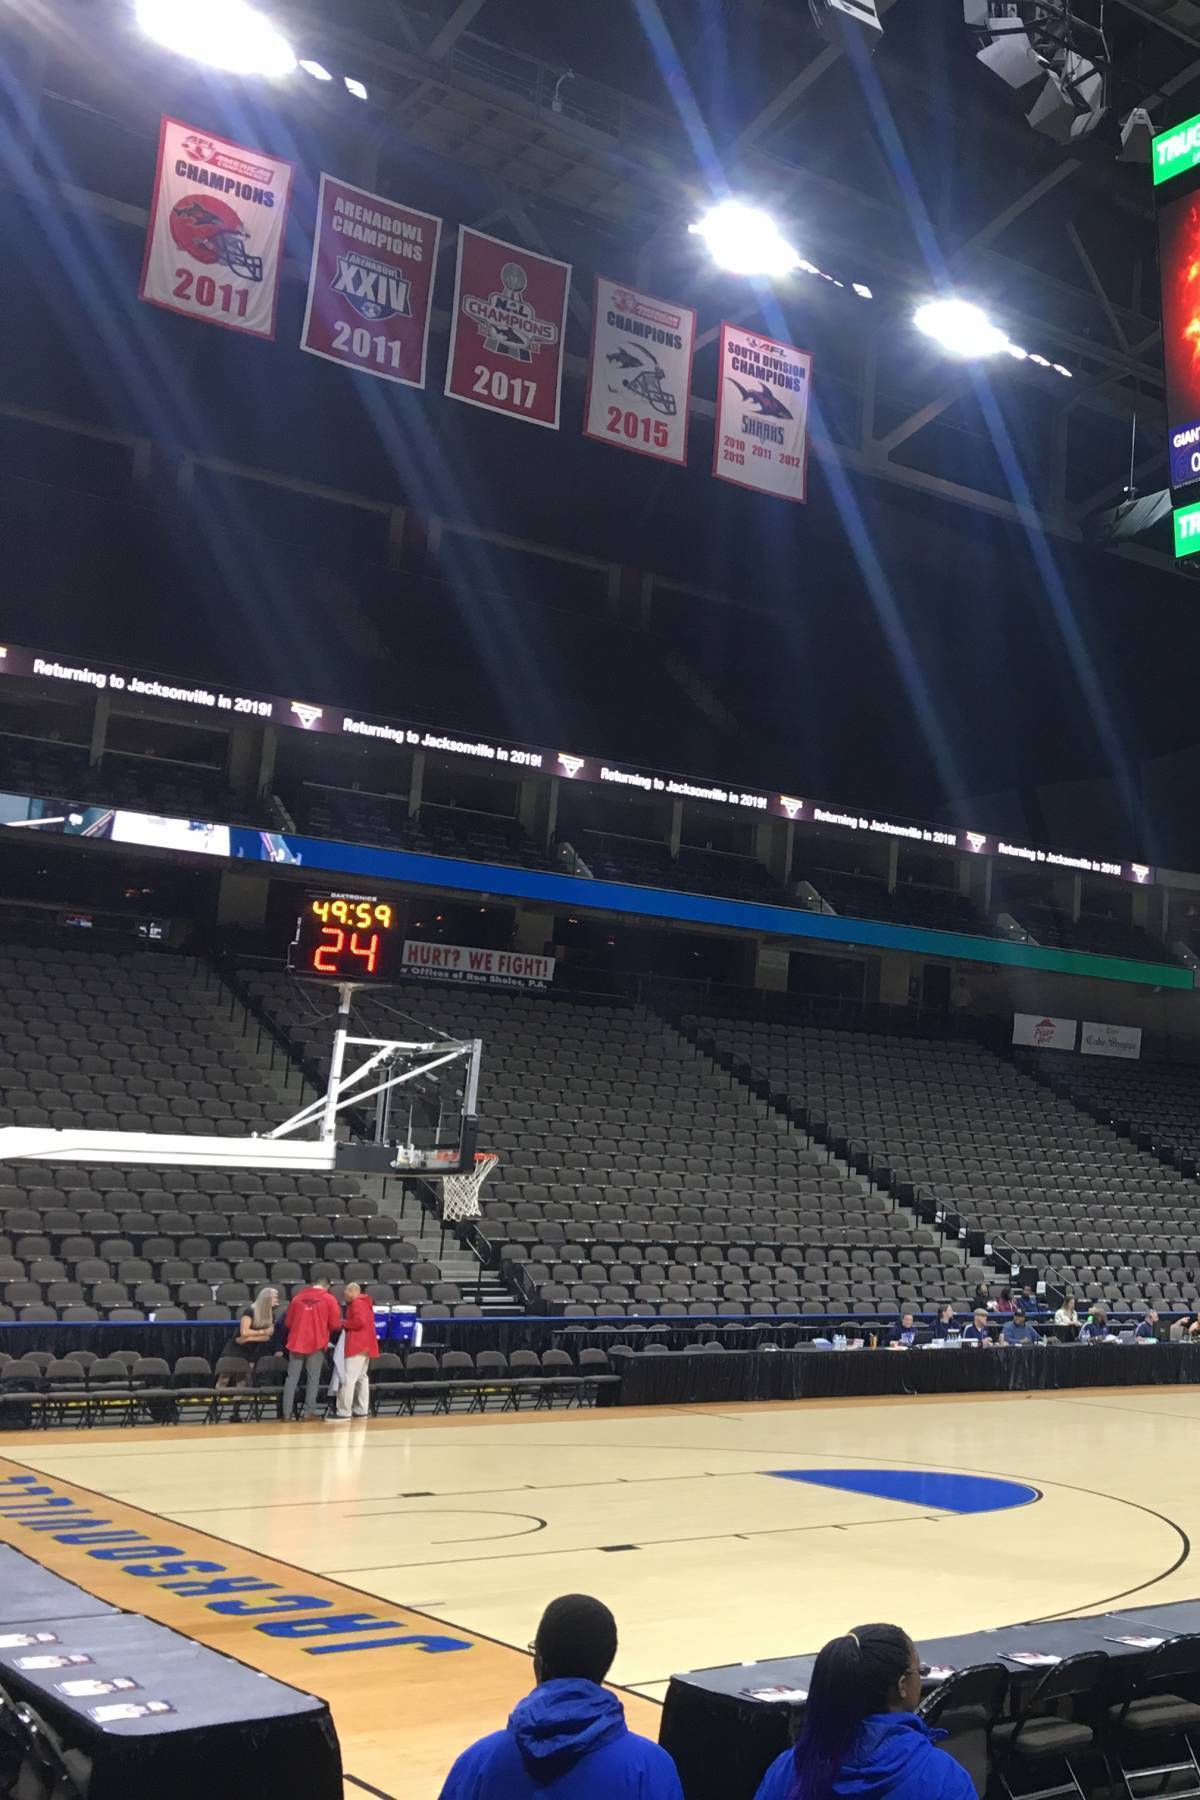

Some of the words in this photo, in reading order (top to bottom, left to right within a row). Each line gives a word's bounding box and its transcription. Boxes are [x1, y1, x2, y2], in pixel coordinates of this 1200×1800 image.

[175, 160, 274, 207] CHAMPIONS
[332, 215, 423, 262] CHAMPIONS
[334, 197, 423, 243] ARENABOWL
[173, 268, 249, 318] 2011
[334, 260, 408, 312] XXIV
[469, 301, 552, 338] CHAMPIONS
[607, 310, 682, 350] CHAMPIONS
[331, 320, 401, 369] 2011
[727, 341, 760, 364] SOUTH
[763, 355, 805, 379] DIVISION
[473, 365, 537, 409] 2017
[731, 357, 800, 392] CHAMPIONS
[607, 405, 669, 448] 2015
[742, 414, 784, 445] SHARKS
[723, 449, 744, 465] 2013
[724, 435, 745, 451] 2010
[752, 445, 772, 460] 2011
[779, 453, 800, 468] 2012
[33, 658, 106, 688] Returning
[110, 673, 124, 689] to
[127, 677, 215, 706] Jacksonville
[218, 694, 231, 709] in
[234, 697, 273, 717] 2019!
[343, 718, 403, 744] Returning
[406, 730, 419, 744] to
[422, 733, 494, 758] Jacksonville
[497, 747, 508, 761] in
[510, 750, 542, 767] 2019!
[600, 767, 651, 790] Returning
[653, 777, 664, 790] to
[666, 780, 727, 802] Jacksonville
[728, 791, 739, 805] in
[740, 794, 767, 810] 2019!
[814, 808, 857, 830] Returning
[859, 819, 868, 830] to
[869, 819, 922, 841] Jacksonville
[924, 830, 931, 842] in
[933, 832, 956, 846] 2019!
[998, 843, 1036, 861] Returning
[1037, 851, 1045, 862] to
[1046, 852, 1091, 871] Jacksonville
[1093, 861, 1100, 872] in
[1101, 863, 1121, 876] 2019!
[312, 900, 392, 928] 49:59
[330, 892, 377, 901] DAKTRONICS
[313, 927, 378, 973] 24
[408, 944, 461, 967] HURT?
[469, 951, 493, 971] WE
[498, 955, 548, 977] FIGHT!
[411, 967, 449, 979] Offices
[452, 972, 464, 980] of
[466, 973, 486, 982] Ron
[528, 980, 547, 989] P.A.
